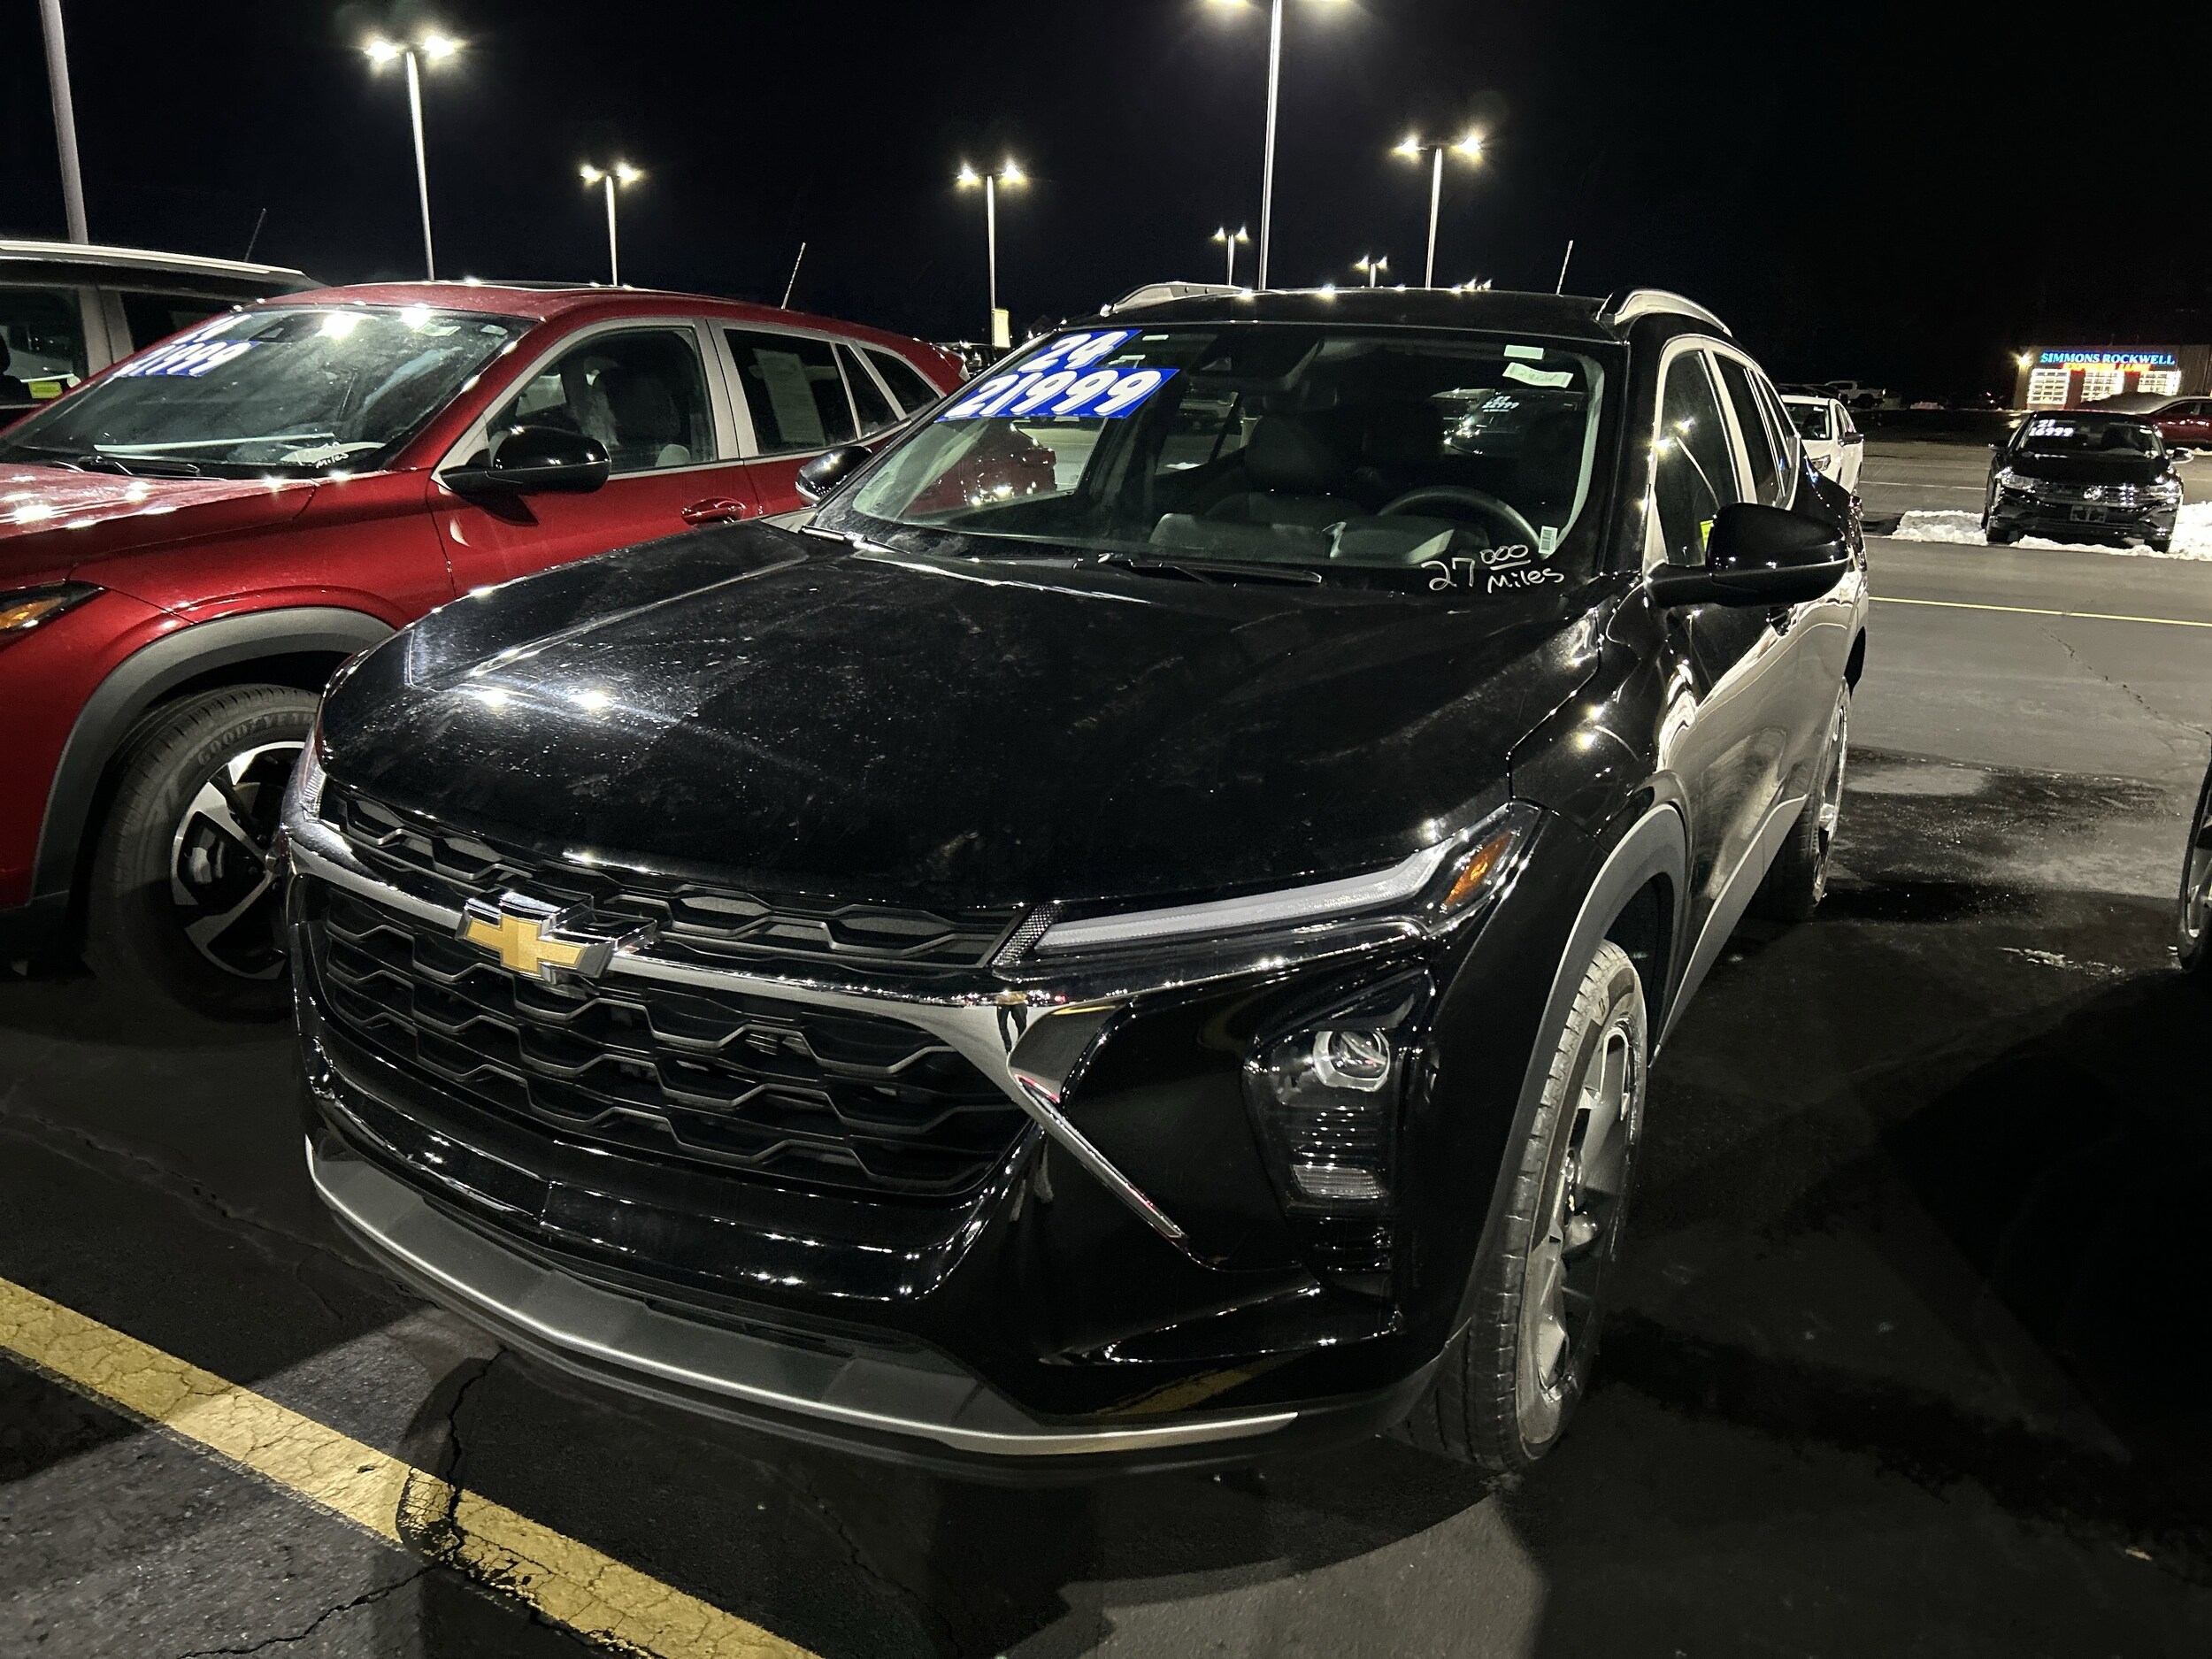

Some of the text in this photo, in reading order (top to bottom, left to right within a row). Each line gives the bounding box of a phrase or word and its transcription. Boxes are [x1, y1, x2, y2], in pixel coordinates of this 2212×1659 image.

[1018, 331, 1129, 373] 24
[2039, 352, 2176, 365] SIMMONS ROCKWELL
[943, 370, 1162, 420] 21999
[1487, 568, 1565, 593] Miles
